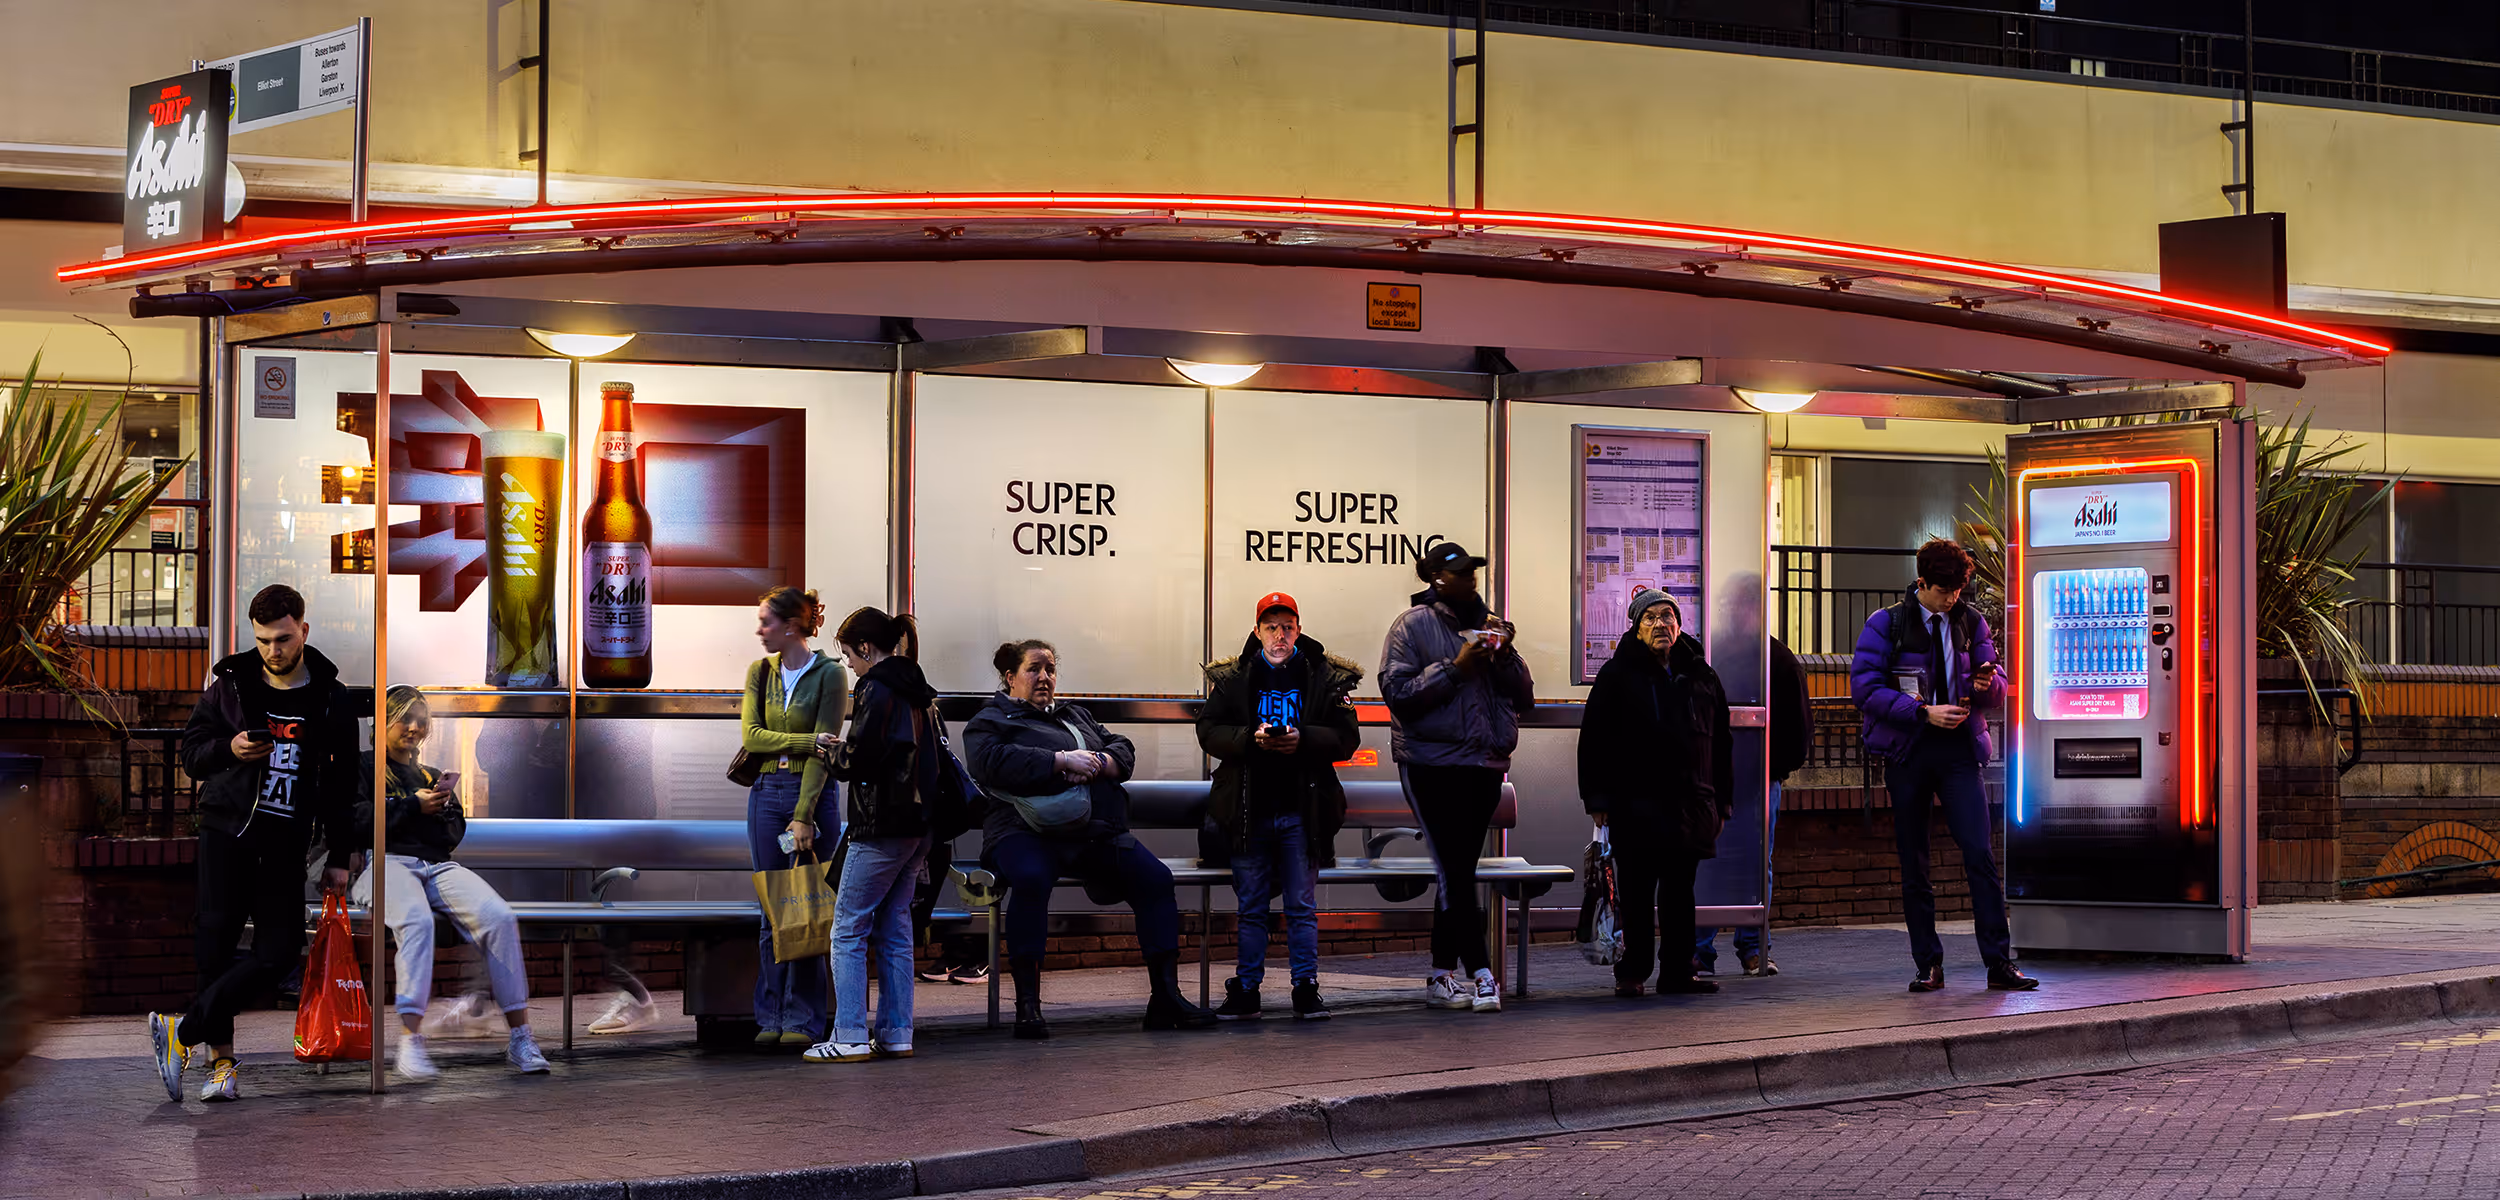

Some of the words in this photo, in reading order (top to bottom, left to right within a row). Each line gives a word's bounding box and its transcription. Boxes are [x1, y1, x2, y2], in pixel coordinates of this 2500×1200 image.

[315, 47, 328, 57] Buses
[328, 41, 346, 54] towards
[321, 58, 339, 69] Allerton
[257, 82, 269, 91] Elliot
[269, 77, 284, 88] Street
[321, 71, 338, 83] Garston
[161, 85, 181, 99] SUPER
[319, 87, 339, 97] Liverpool
[127, 110, 207, 200] Asahi
[147, 201, 181, 239] 辛口
[1385, 300, 1416, 309] stopping
[1381, 309, 1407, 317] except
[1372, 317, 1391, 326] local
[1393, 318, 1416, 327] buses
[1006, 480, 1116, 516] SUPER
[1295, 490, 1398, 525] SUPER
[2074, 501, 2117, 527] Asahi
[501, 472, 537, 576] Asahi
[1012, 522, 1117, 557] CRISP.
[589, 577, 646, 606] Asahi
[604, 612, 630, 625] 辛口
[781, 890, 836, 905] PRIMAR
